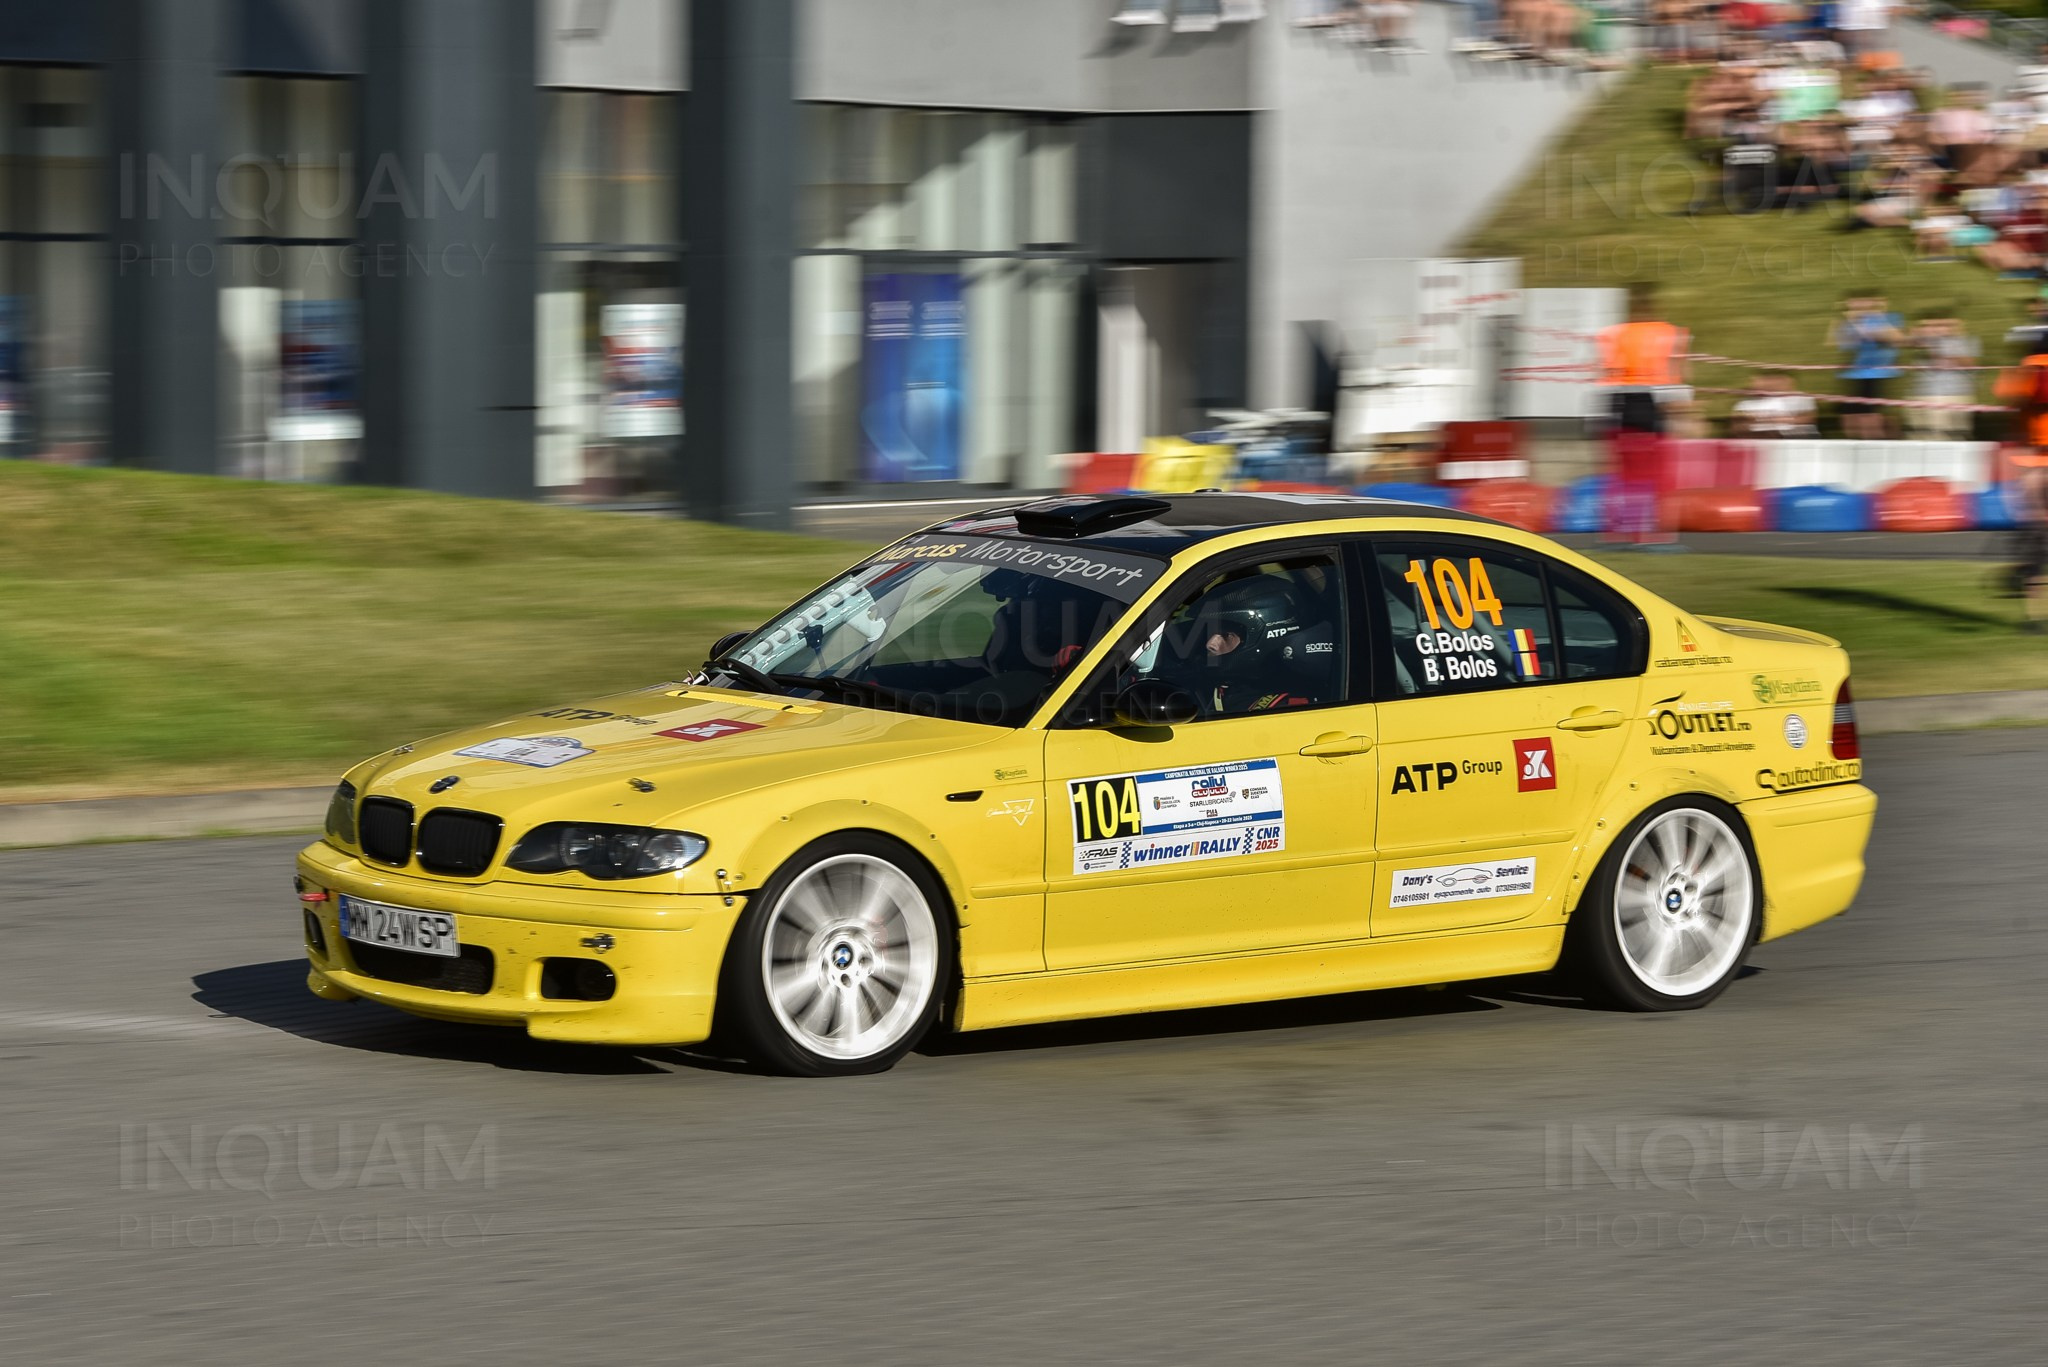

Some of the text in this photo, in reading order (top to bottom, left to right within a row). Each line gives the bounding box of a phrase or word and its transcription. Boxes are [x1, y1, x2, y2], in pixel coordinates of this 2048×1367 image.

[960, 540, 1143, 587] Motorsport
[1404, 557, 1503, 630] 104
[1266, 627, 1288, 639] ATP
[1415, 631, 1495, 655] G.Bolos
[1423, 655, 1498, 682] B. Bolos
[1191, 775, 1227, 790] raliul
[1391, 760, 1503, 795] ATP Group
[1073, 778, 1142, 840] 104
[1256, 826, 1281, 839] CNR
[1087, 847, 1119, 858] FRAS
[1134, 837, 1242, 862] winner RALLY
[1255, 838, 1279, 852] 2025
[1402, 865, 1530, 887] Dany's Service
[1476, 886, 1492, 895] auto
